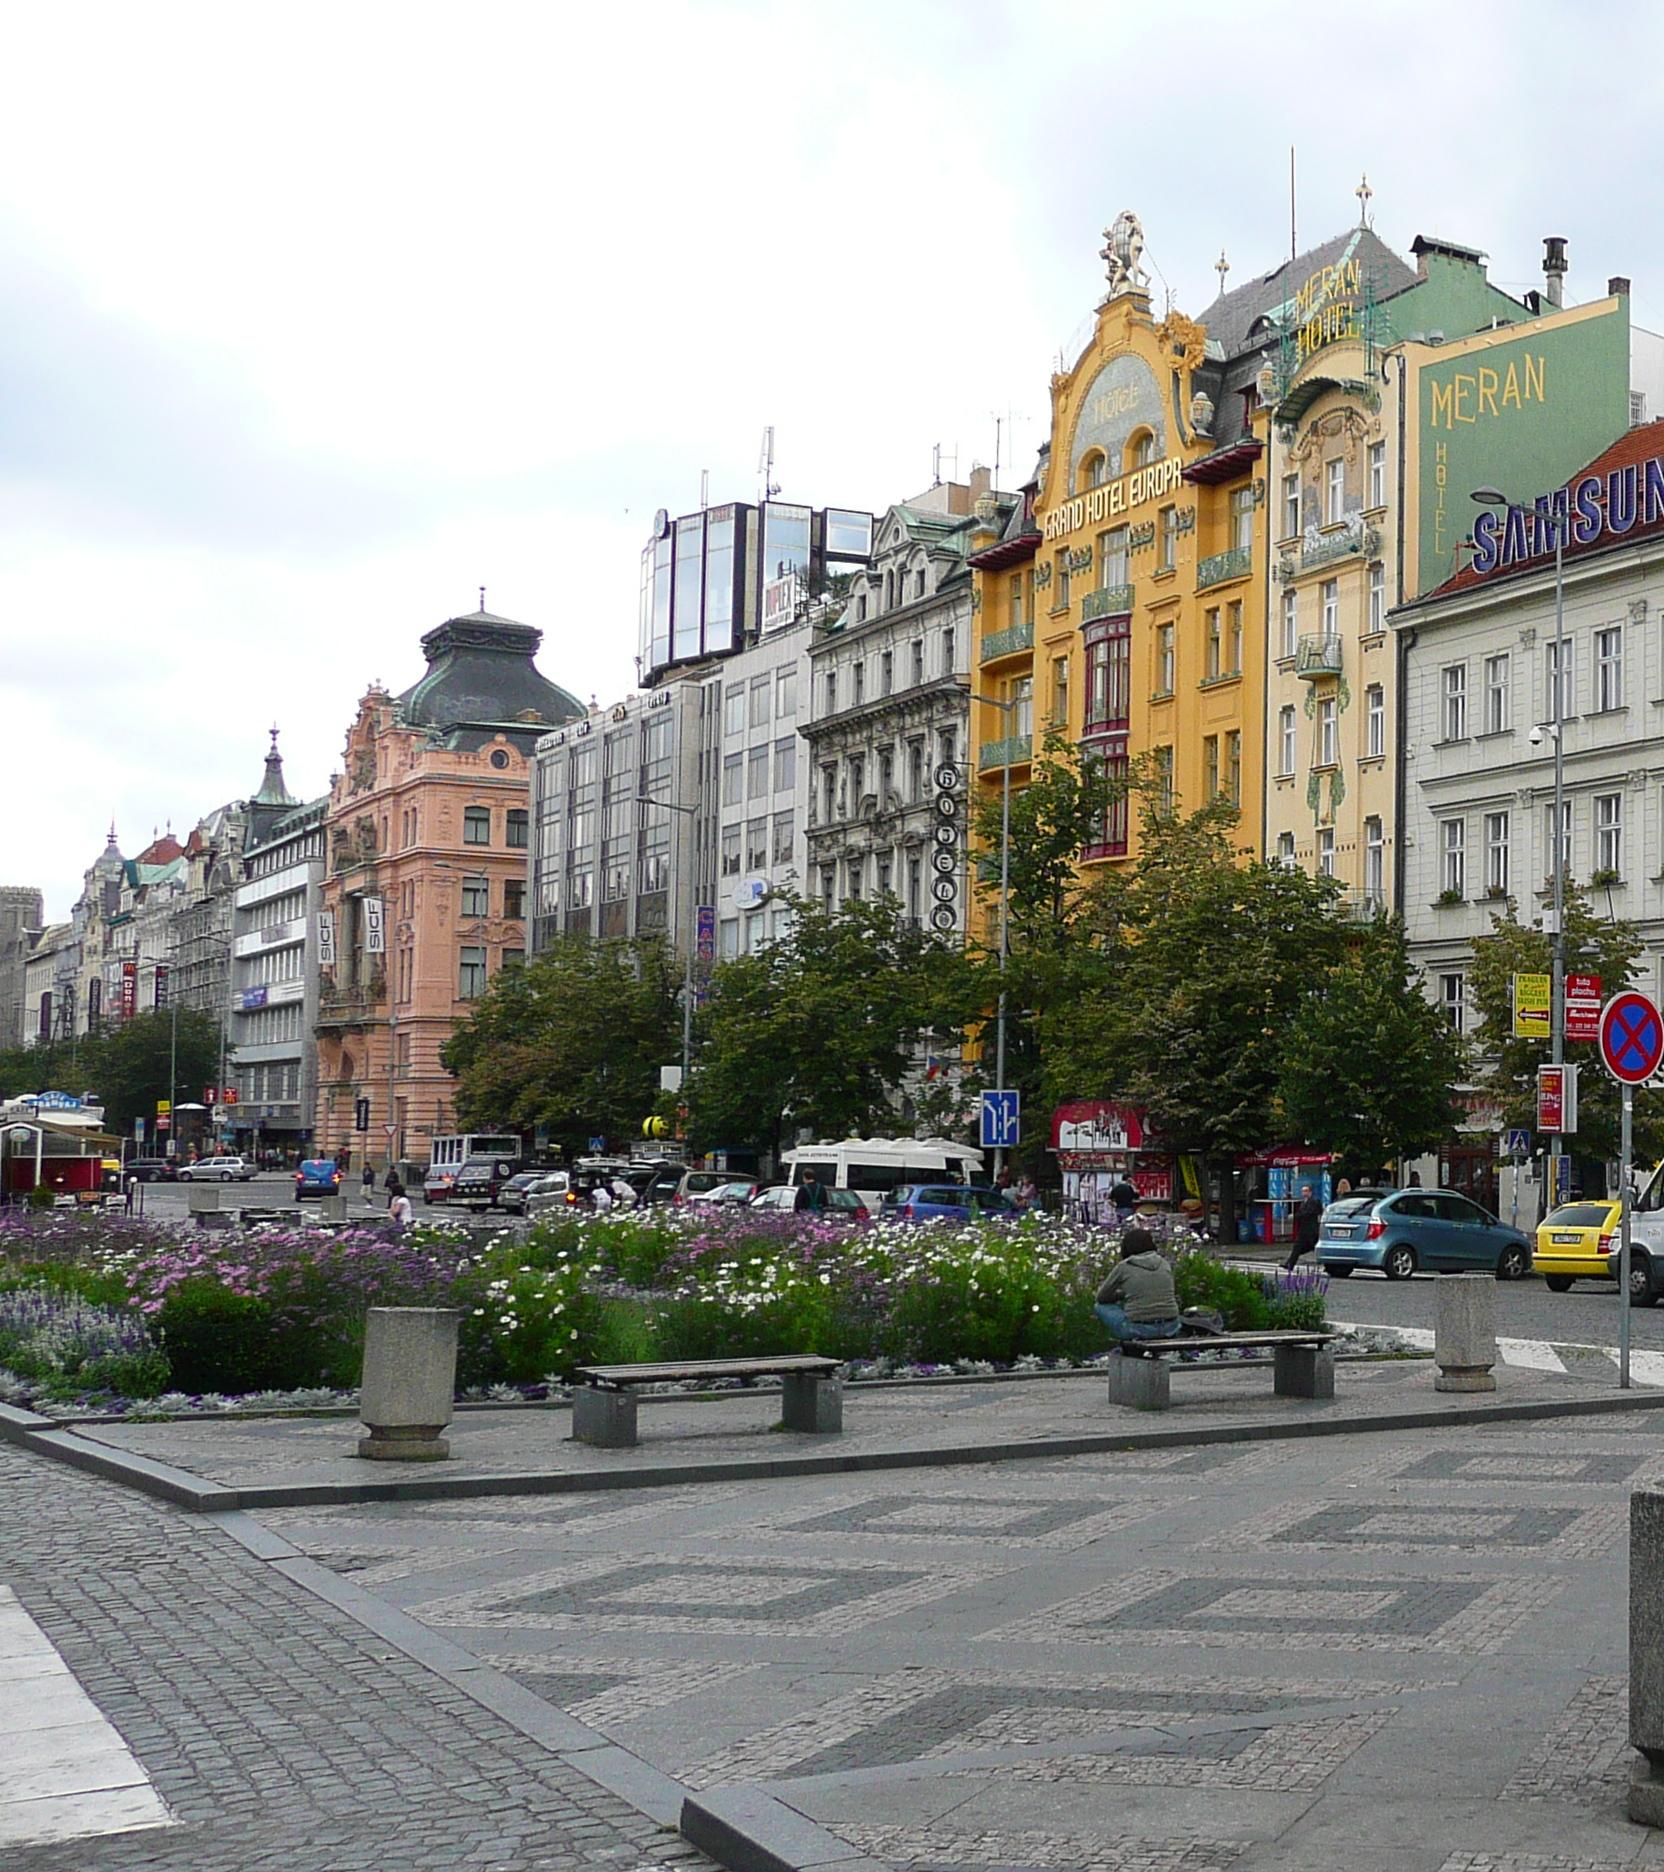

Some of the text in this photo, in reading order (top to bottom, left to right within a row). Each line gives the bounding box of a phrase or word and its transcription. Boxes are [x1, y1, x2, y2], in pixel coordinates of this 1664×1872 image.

[1296, 259, 1361, 324] MERAN
[1297, 302, 1361, 363] HOTEL
[1431, 354, 1546, 429] MERAN
[1044, 457, 1183, 541] GRAND HOTEL EUROPA
[1436, 441, 1447, 555] HOTEL
[368, 901, 380, 949] SICF
